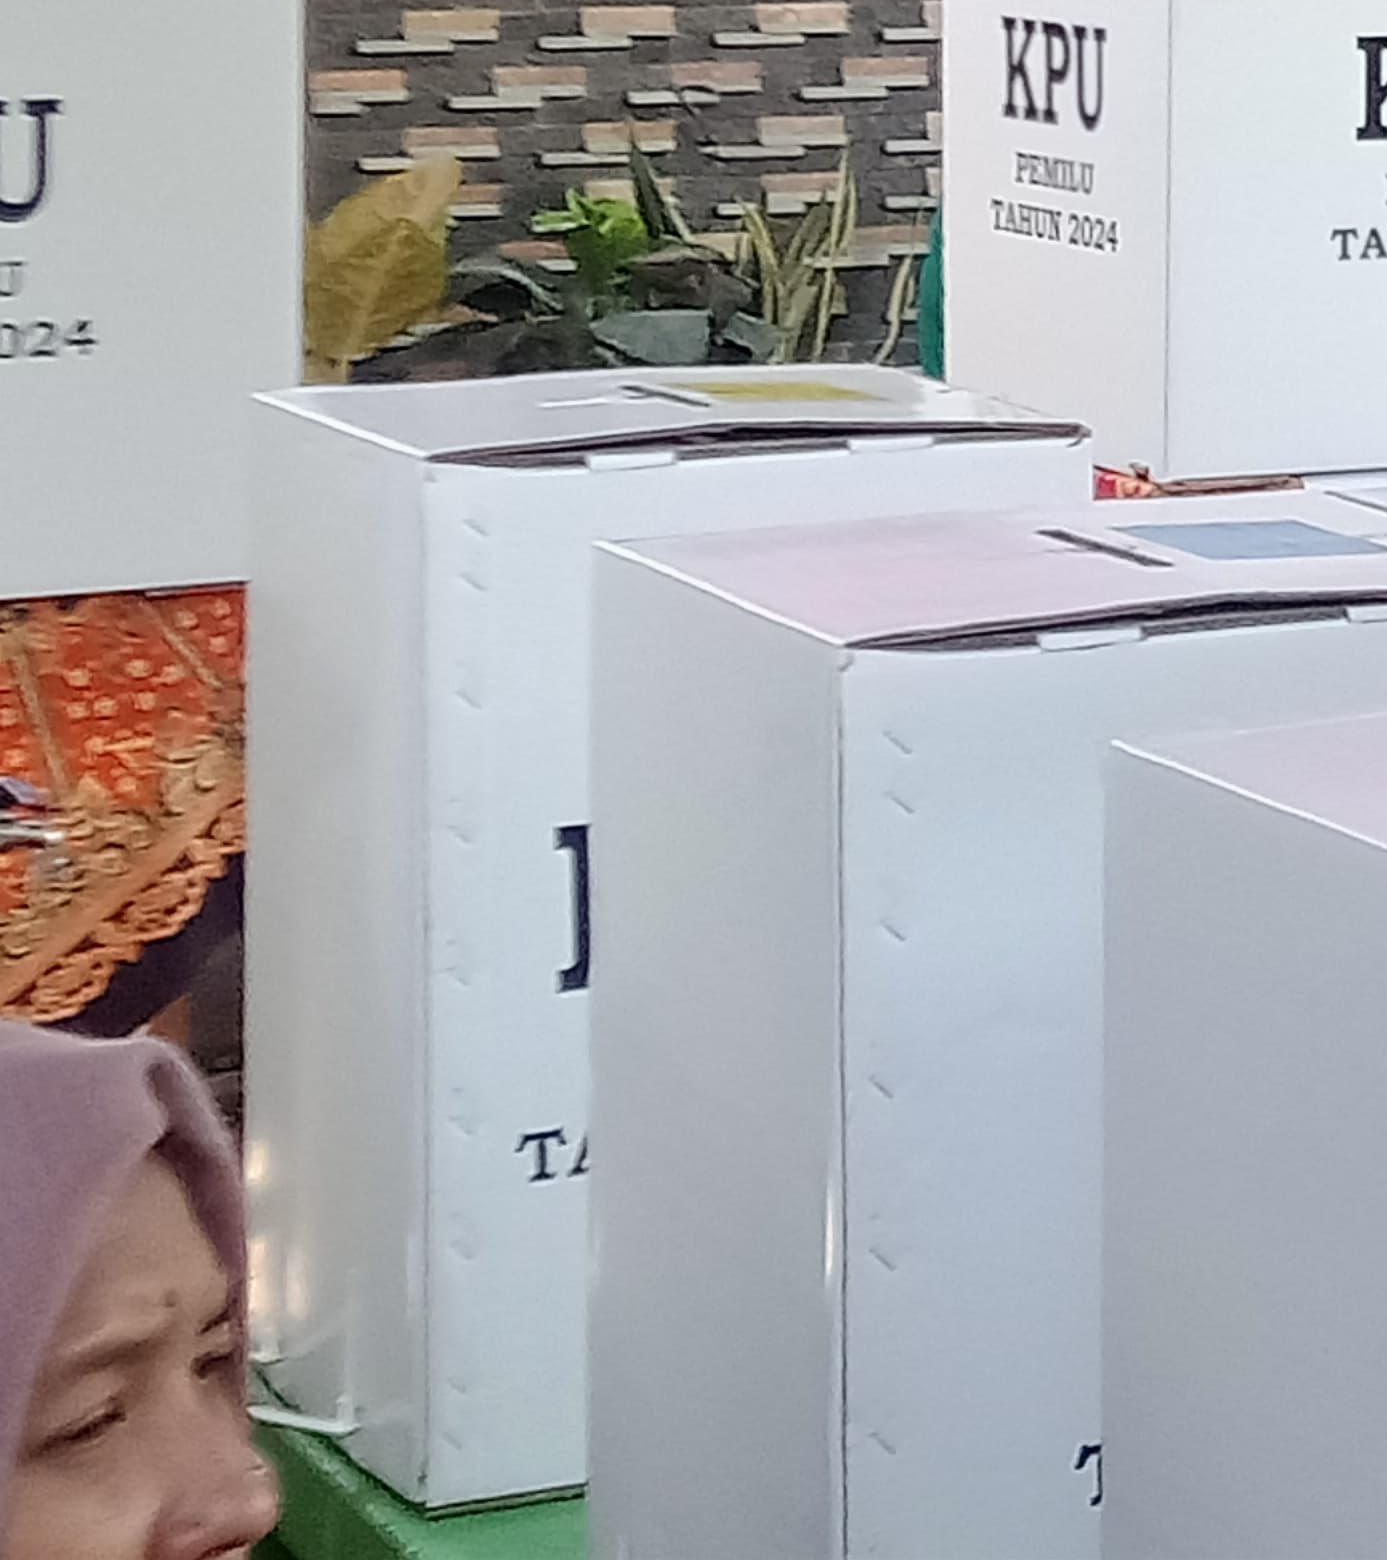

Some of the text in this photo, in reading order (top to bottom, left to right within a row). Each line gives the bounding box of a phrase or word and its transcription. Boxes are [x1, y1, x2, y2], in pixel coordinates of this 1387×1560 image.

[1001, 15, 1107, 132] KPU
[1014, 151, 1096, 196] PEMILU
[991, 198, 1119, 253] TAHUN 2024
[0, 320, 98, 359] 024
